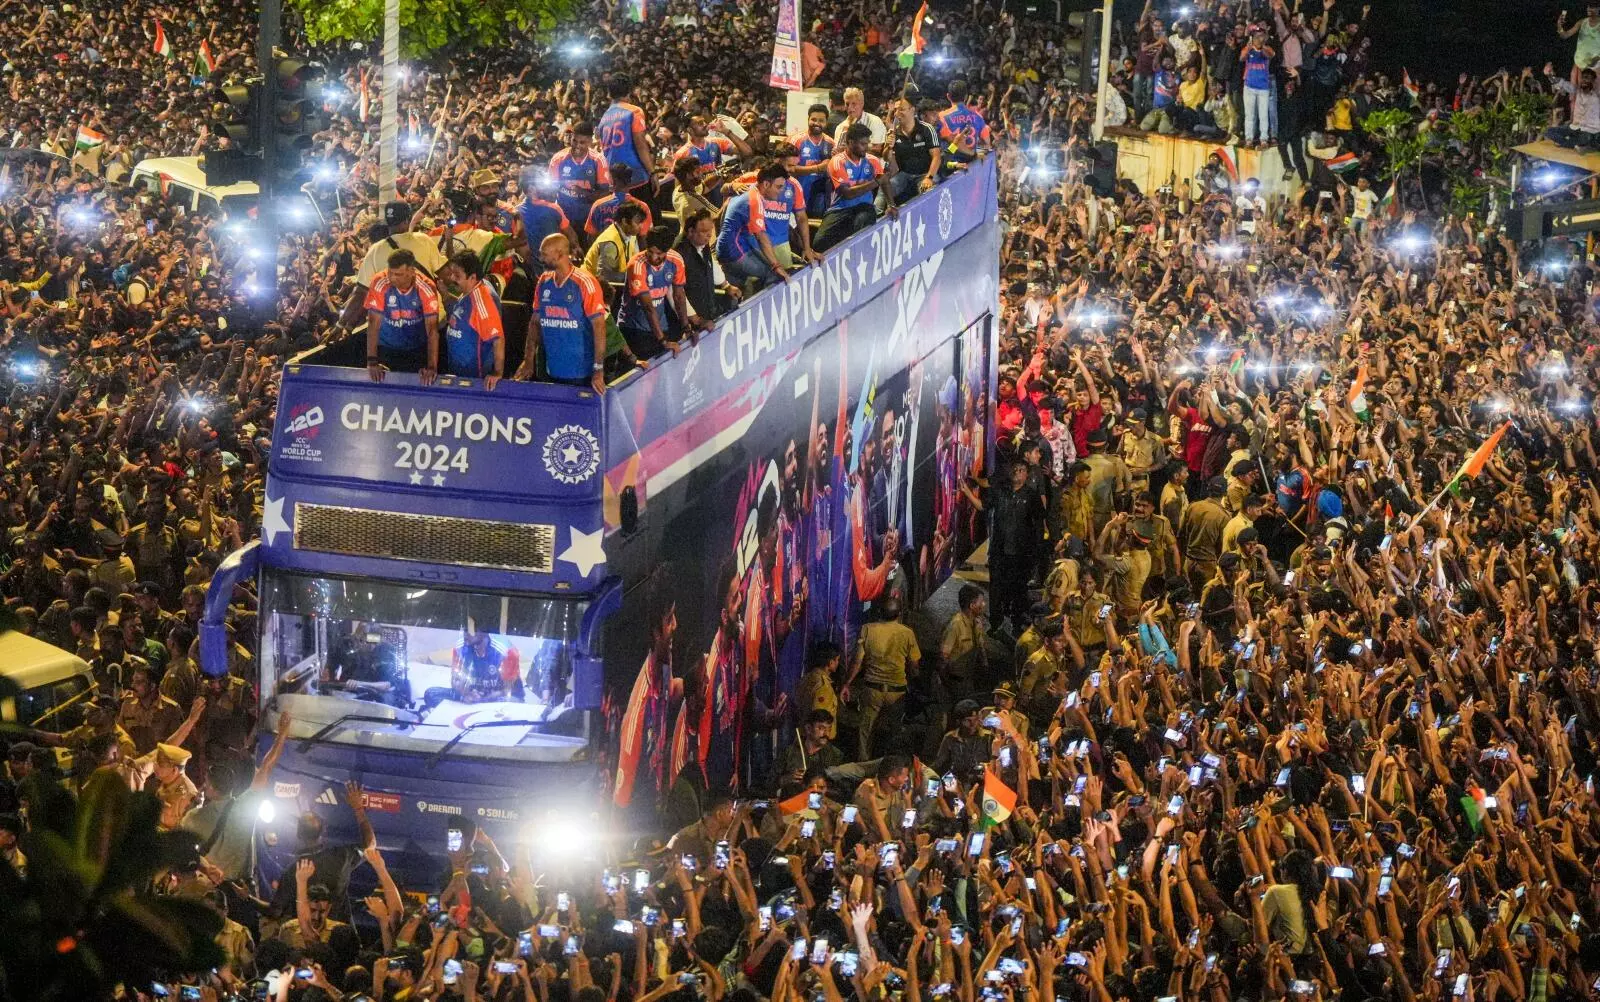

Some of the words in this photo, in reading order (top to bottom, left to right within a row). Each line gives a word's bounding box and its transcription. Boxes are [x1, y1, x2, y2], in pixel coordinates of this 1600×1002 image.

[950, 114, 977, 124] VIRAT
[719, 248, 853, 380] CHAMPIONS
[871, 211, 913, 284] 2024
[540, 318, 579, 329] CHAMPIONS
[340, 402, 532, 445] CHAMPIONS
[282, 447, 306, 456] WORLD
[306, 449, 322, 457] CUP
[394, 441, 469, 474] 2024
[428, 803, 462, 816] DREAM11
